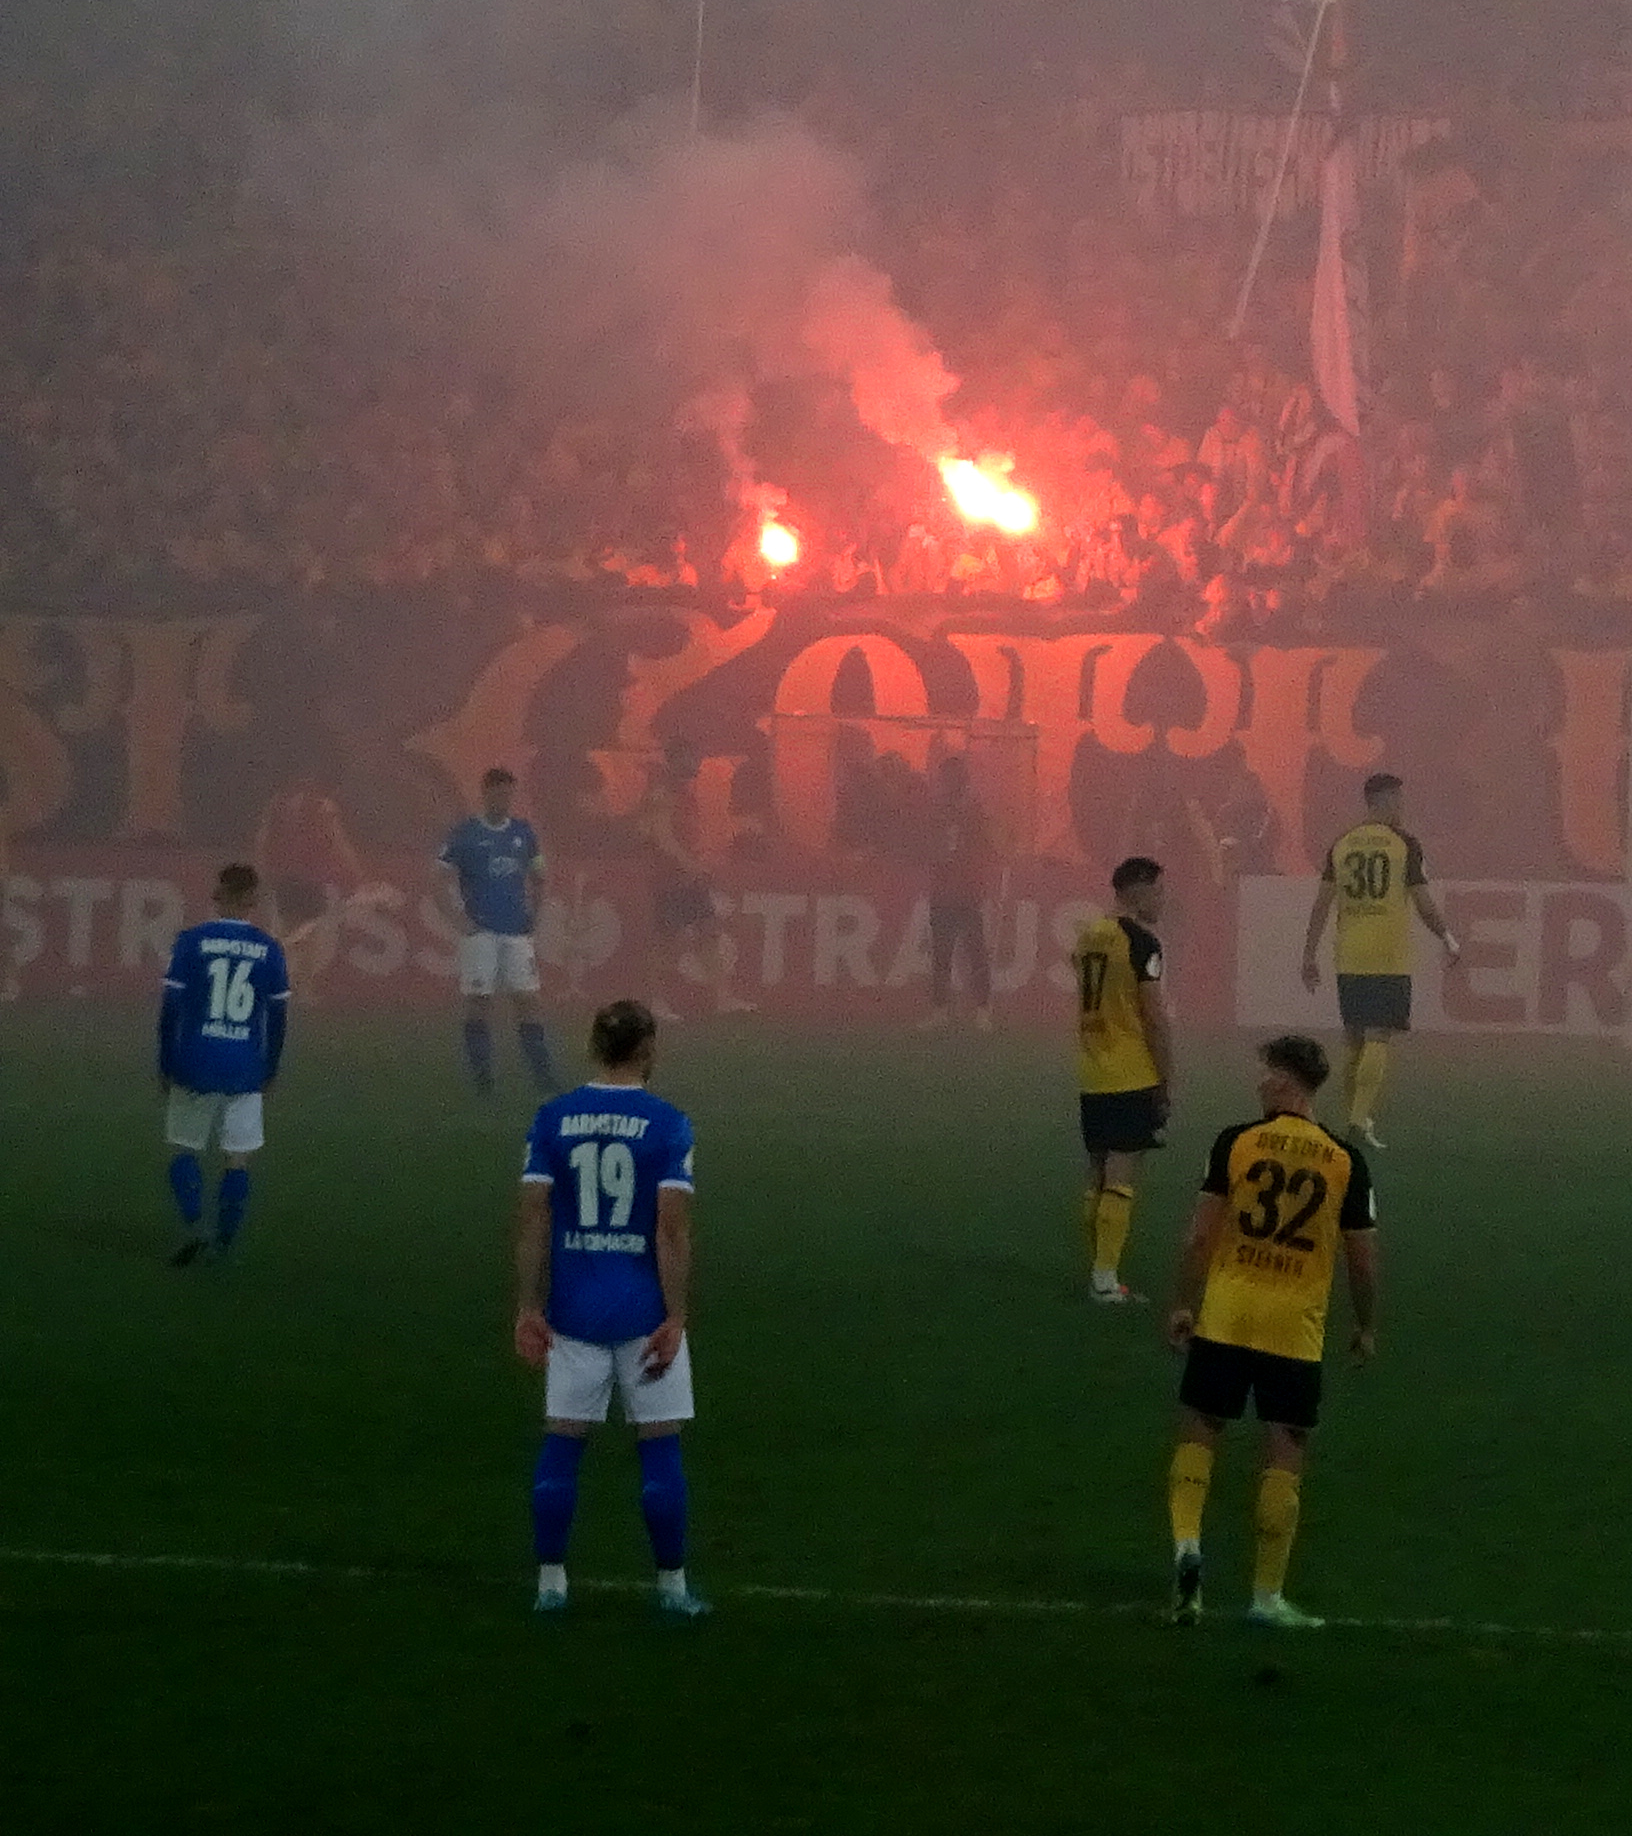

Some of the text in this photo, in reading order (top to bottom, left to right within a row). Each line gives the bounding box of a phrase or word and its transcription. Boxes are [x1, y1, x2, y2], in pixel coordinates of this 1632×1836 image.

[1343, 850, 1391, 900] 30
[208, 957, 255, 1022] 16
[569, 1140, 636, 1227] 19
[1238, 1157, 1328, 1252] 32
